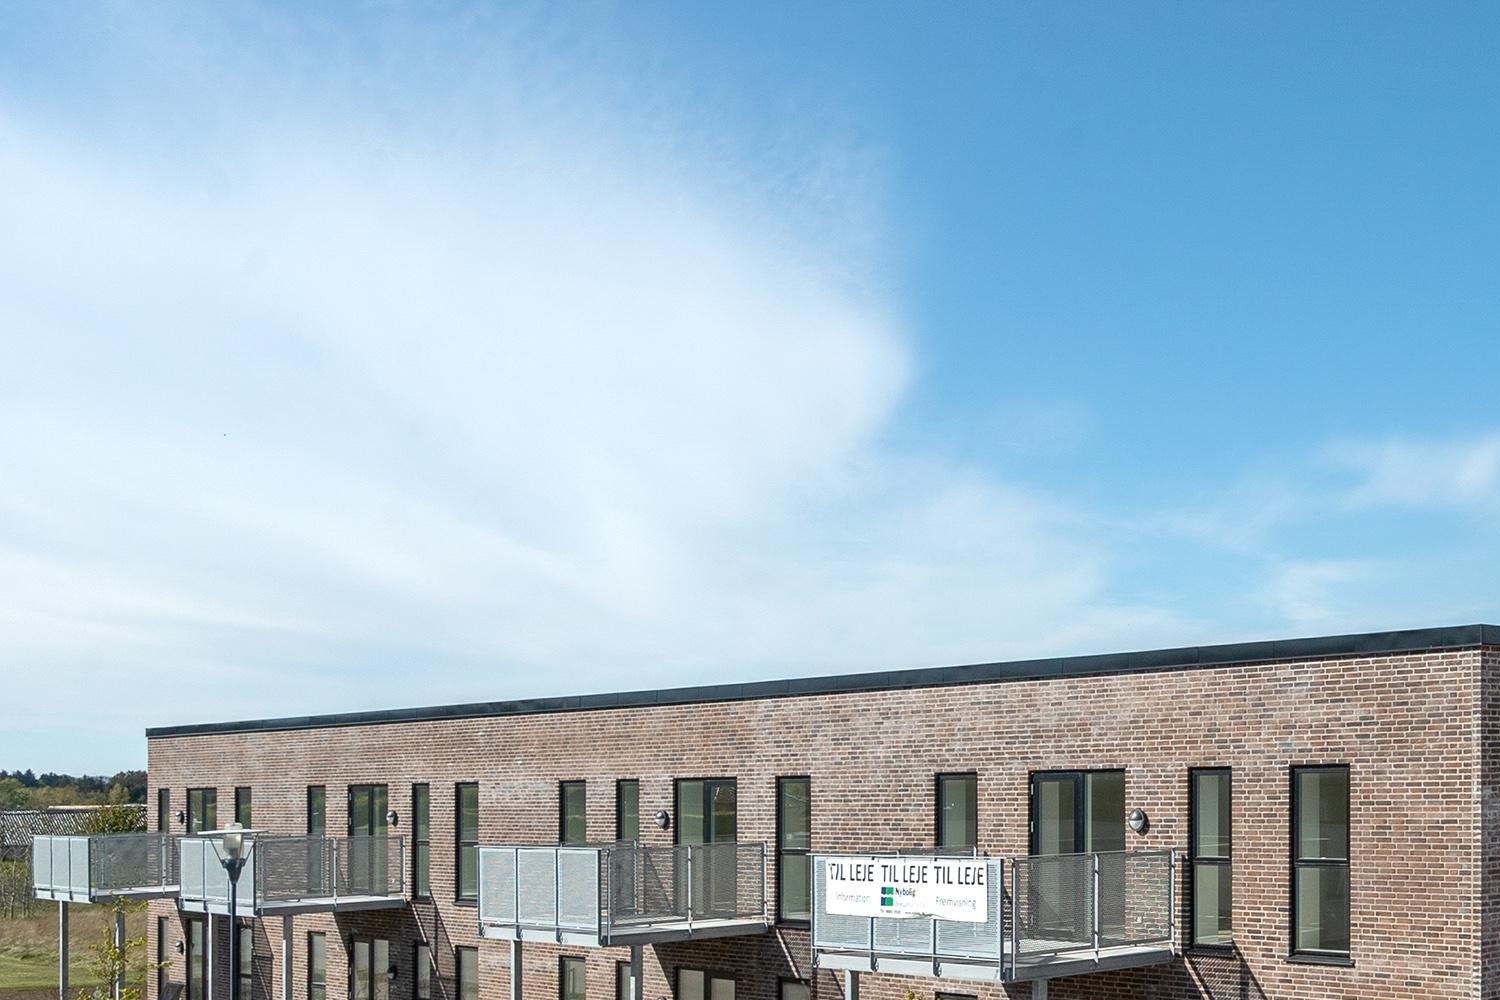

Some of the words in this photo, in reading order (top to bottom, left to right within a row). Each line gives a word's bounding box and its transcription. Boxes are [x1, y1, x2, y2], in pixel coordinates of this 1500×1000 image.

[828, 863, 846, 881] TIL
[850, 864, 874, 882] LEJE
[881, 864, 899, 883] TIL
[903, 865, 928, 883] LEJE
[934, 866, 953, 884] TIL
[958, 866, 984, 886] LEJE
[895, 887, 916, 897] Nybolig
